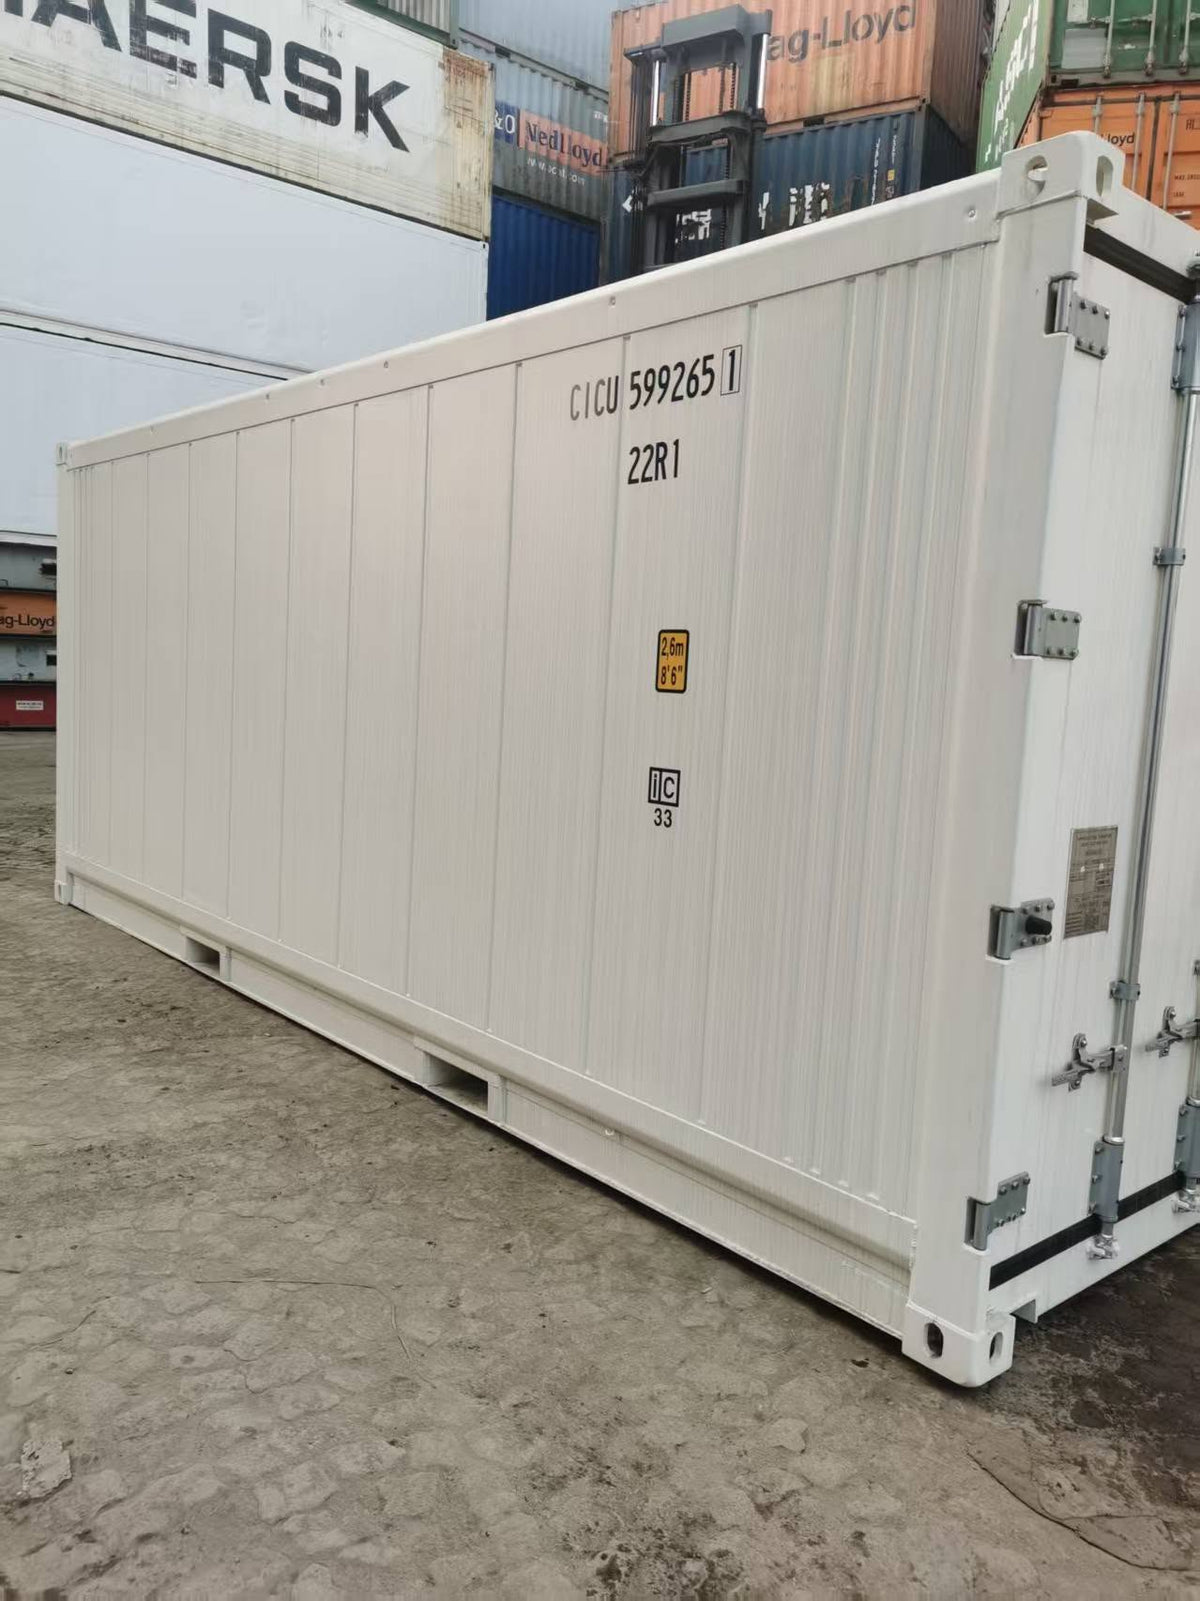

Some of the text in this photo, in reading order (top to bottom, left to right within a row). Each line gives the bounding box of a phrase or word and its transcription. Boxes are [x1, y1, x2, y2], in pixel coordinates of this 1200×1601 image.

[1100, 132, 1135, 147] loyd
[570, 374, 619, 421] CICU
[629, 354, 715, 410] 599265
[627, 438, 680, 485] 22R1
[653, 807, 673, 828] 33
